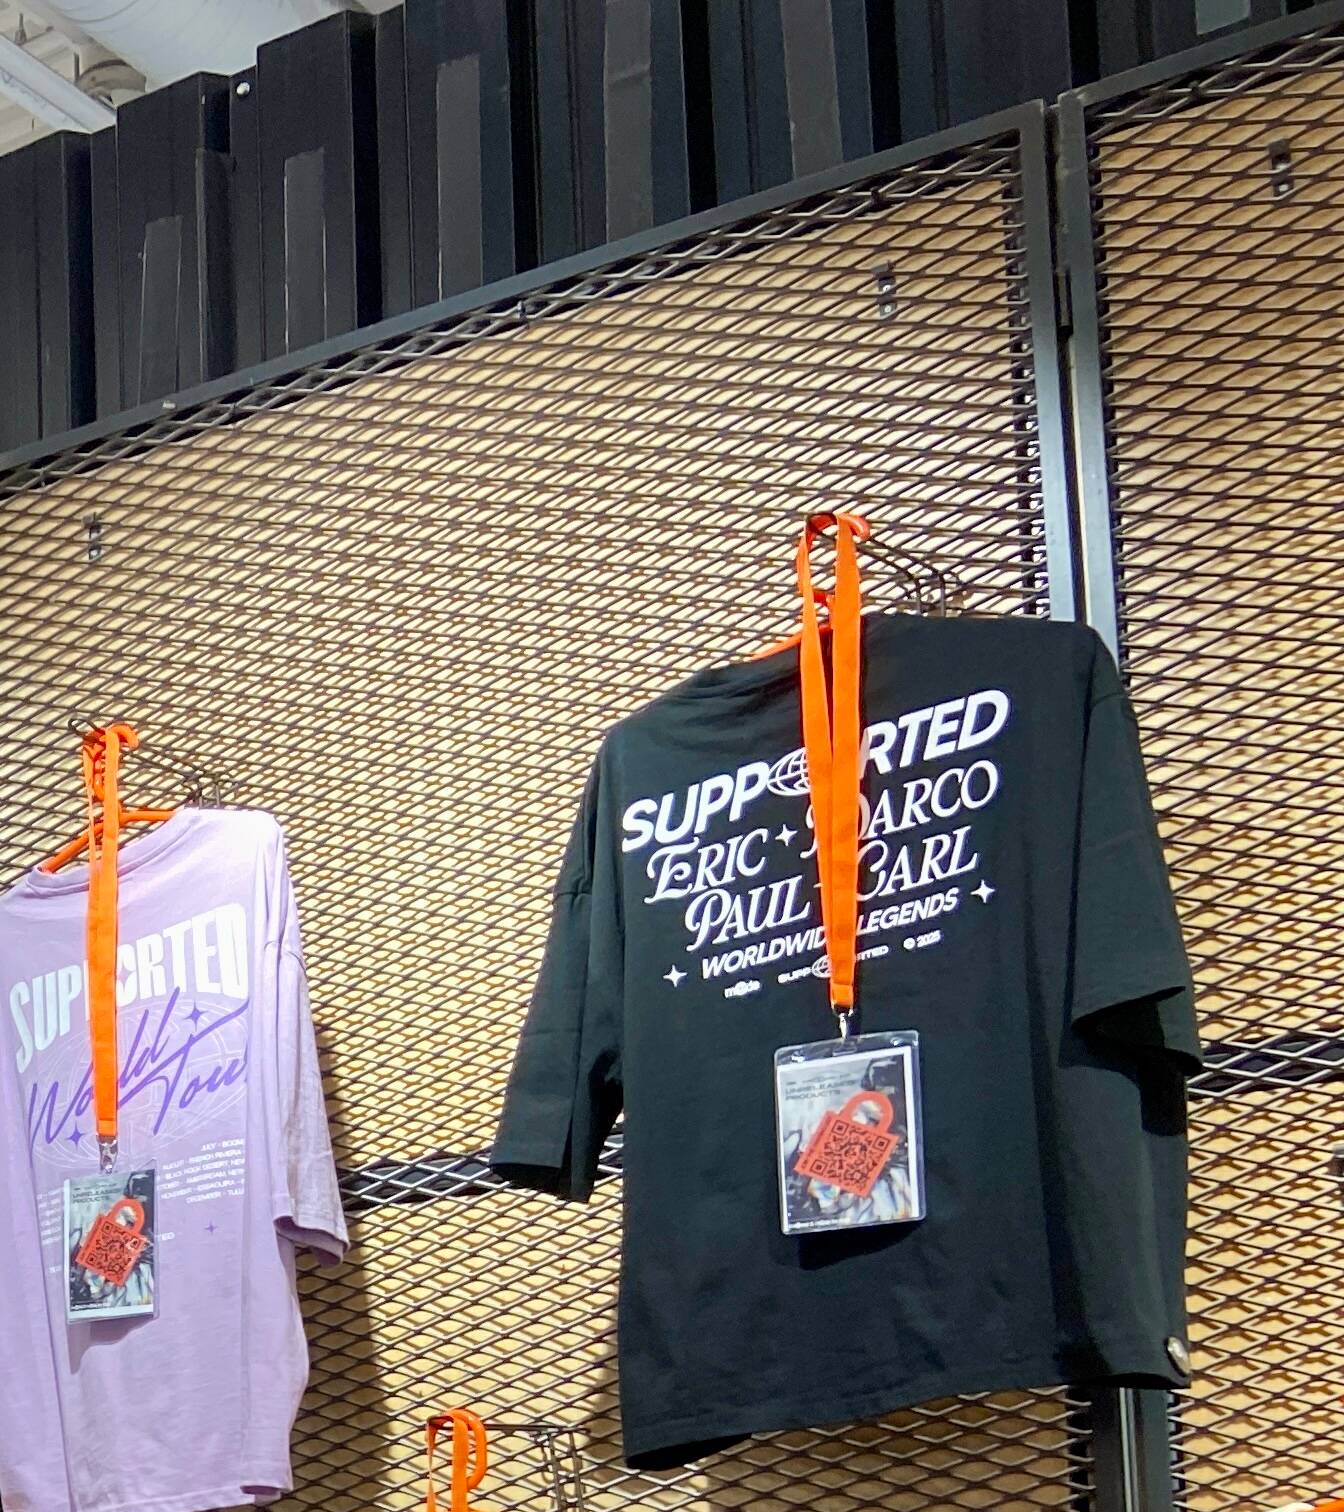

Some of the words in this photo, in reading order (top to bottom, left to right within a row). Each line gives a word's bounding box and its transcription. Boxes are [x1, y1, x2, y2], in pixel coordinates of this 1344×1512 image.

[644, 828, 768, 904] ERIC
[684, 875, 811, 952] PAUL
[701, 924, 830, 980] WORLDWID
[857, 889, 959, 935] LEGENDS
[9, 902, 249, 1075] SUPORTED
[27, 986, 180, 1149] Wold
